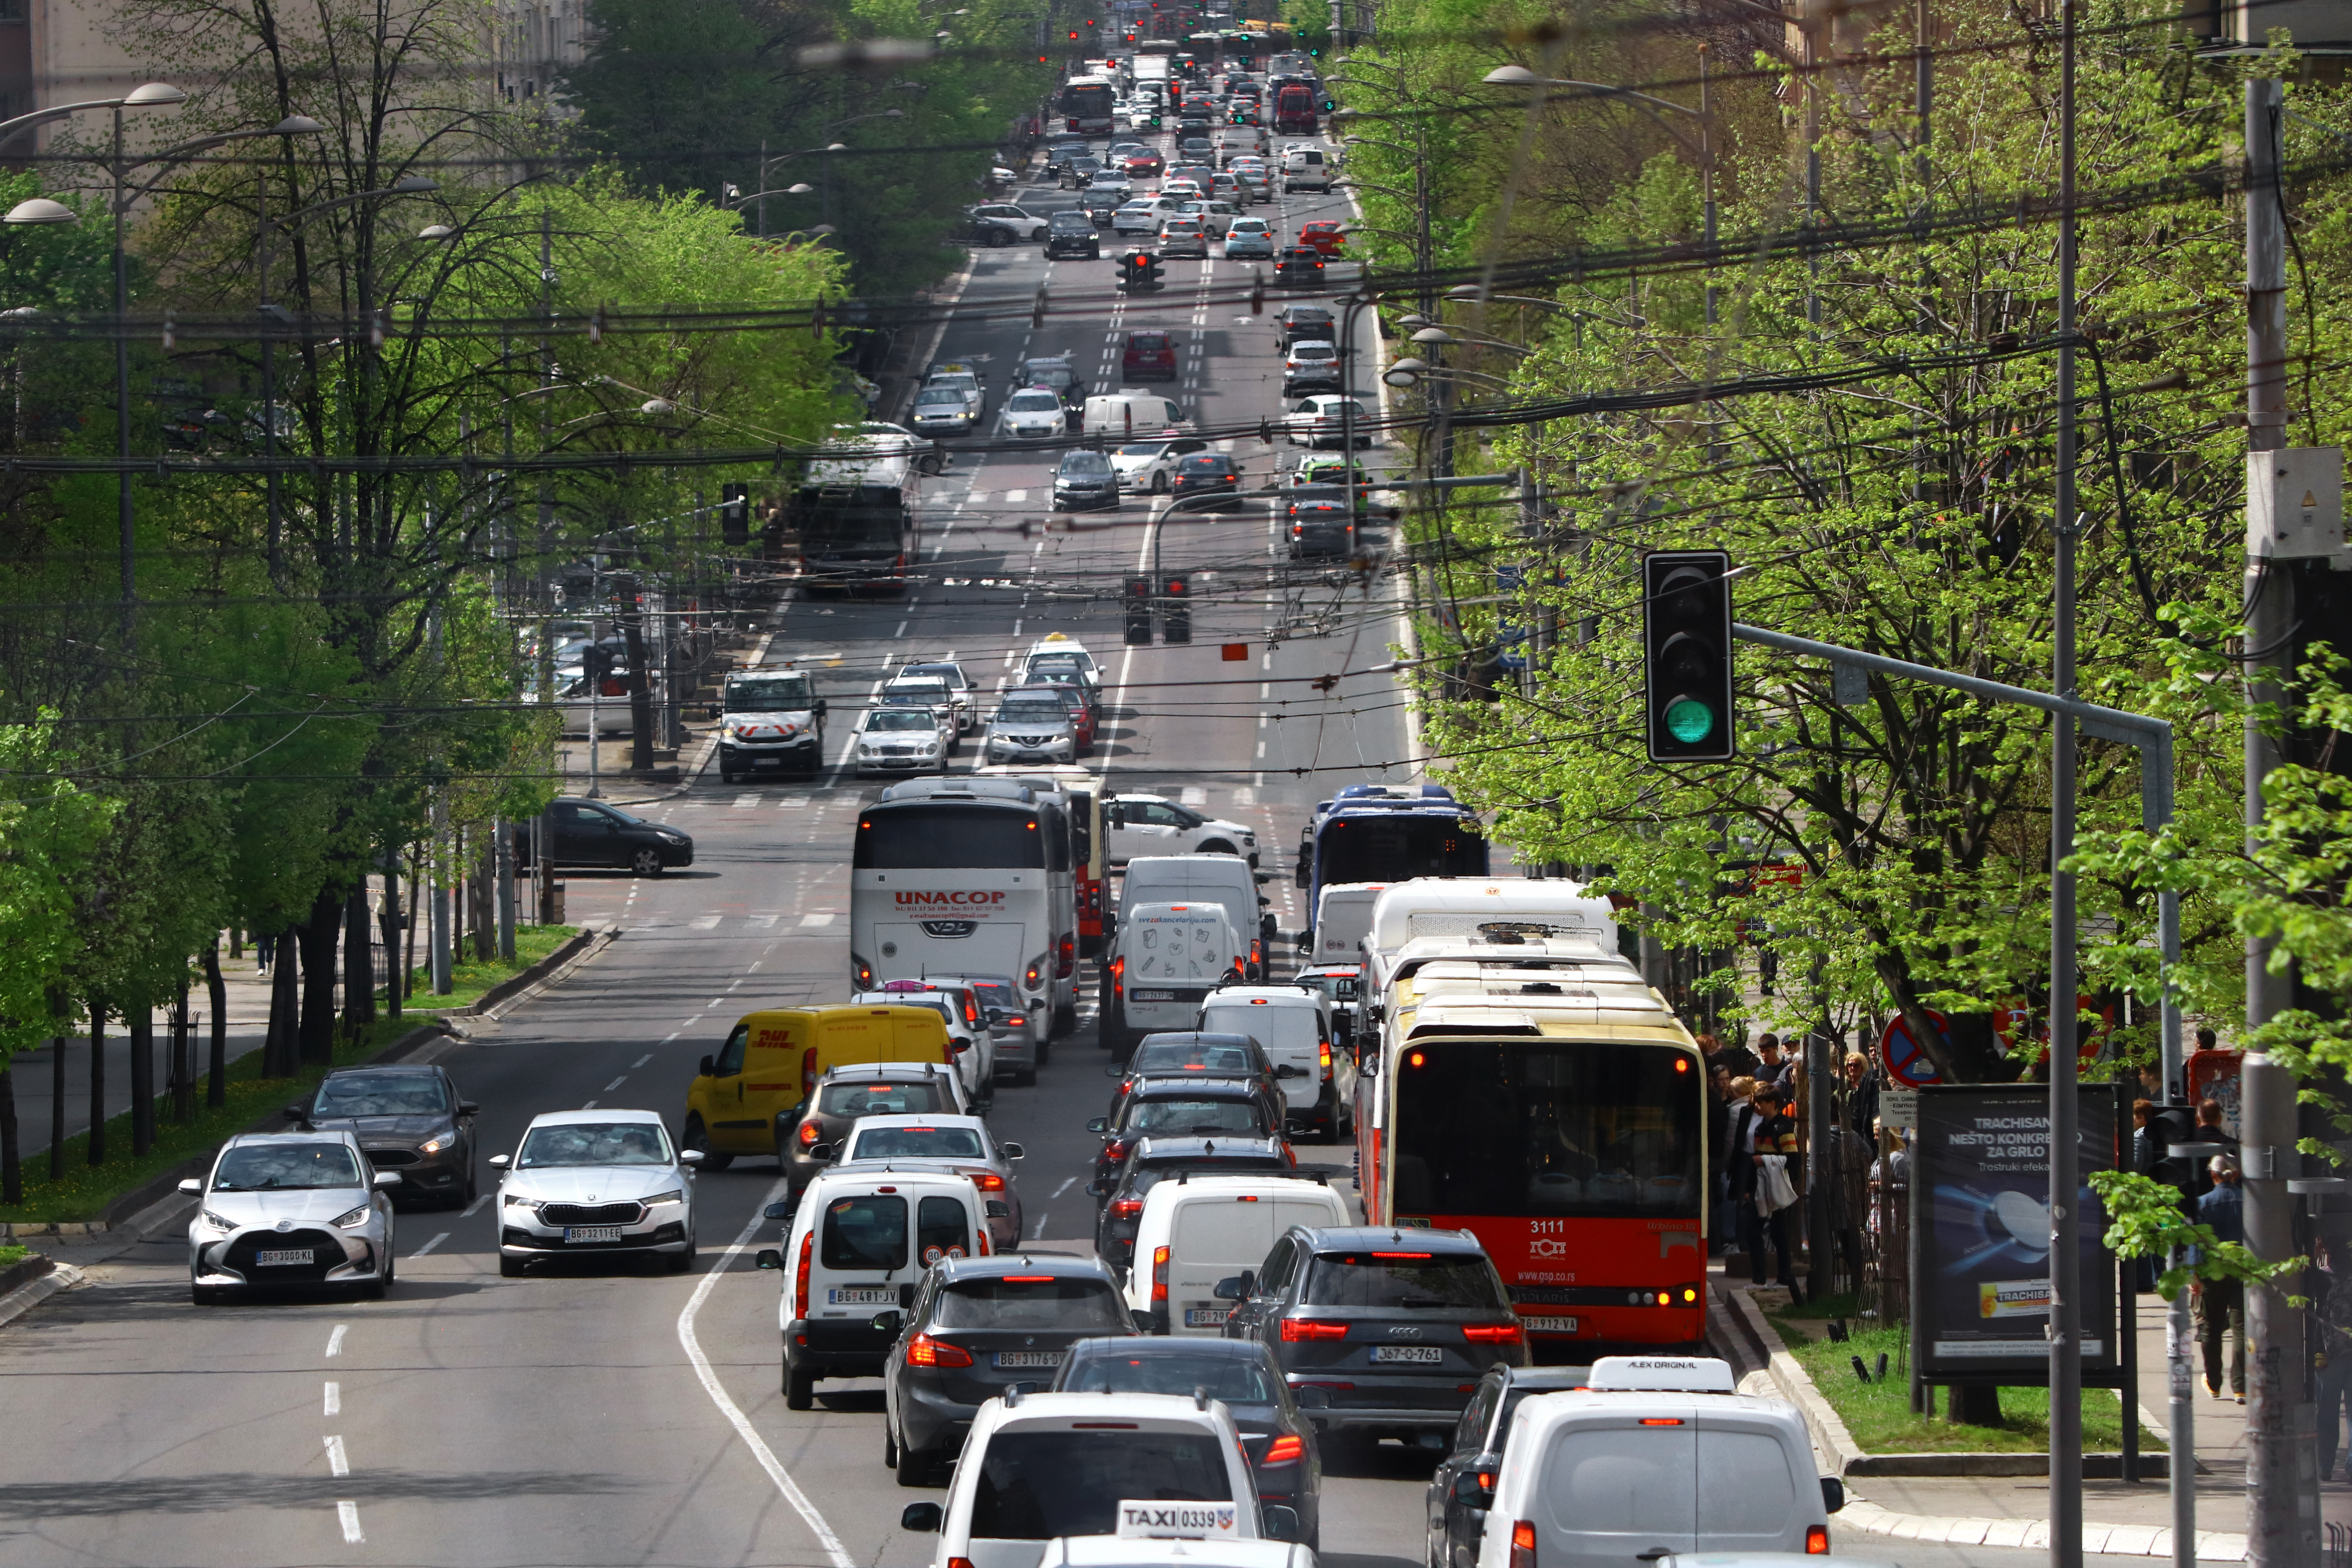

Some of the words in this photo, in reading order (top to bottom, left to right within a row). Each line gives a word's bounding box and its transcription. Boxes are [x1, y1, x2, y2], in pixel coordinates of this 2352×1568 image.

[895, 891, 1005, 904] UNACOP
[1138, 916, 1216, 924] svezakancelariju.com
[1948, 1130, 1994, 1145] NEŠTO
[1986, 1146, 2005, 1157] ZA
[2007, 1146, 2045, 1157] GRLO
[1977, 1162, 2020, 1171] Trostruki
[2023, 1163, 2050, 1171] efeka
[1530, 1220, 1563, 1233] 3111
[572, 1229, 581, 1238] BG
[262, 1252, 273, 1262] BG
[928, 1252, 939, 1260] 80
[1518, 1272, 1575, 1283] www.gsp.co.rs
[838, 1291, 851, 1302] BG
[1522, 1293, 1569, 1302] SOLARIS
[1998, 1290, 2050, 1301] TRACHISA
[1194, 1312, 1205, 1322] BG
[1001, 1353, 1014, 1365] BG
[1124, 1509, 1176, 1526] TAXI
[1181, 1510, 1215, 1527] 0339
